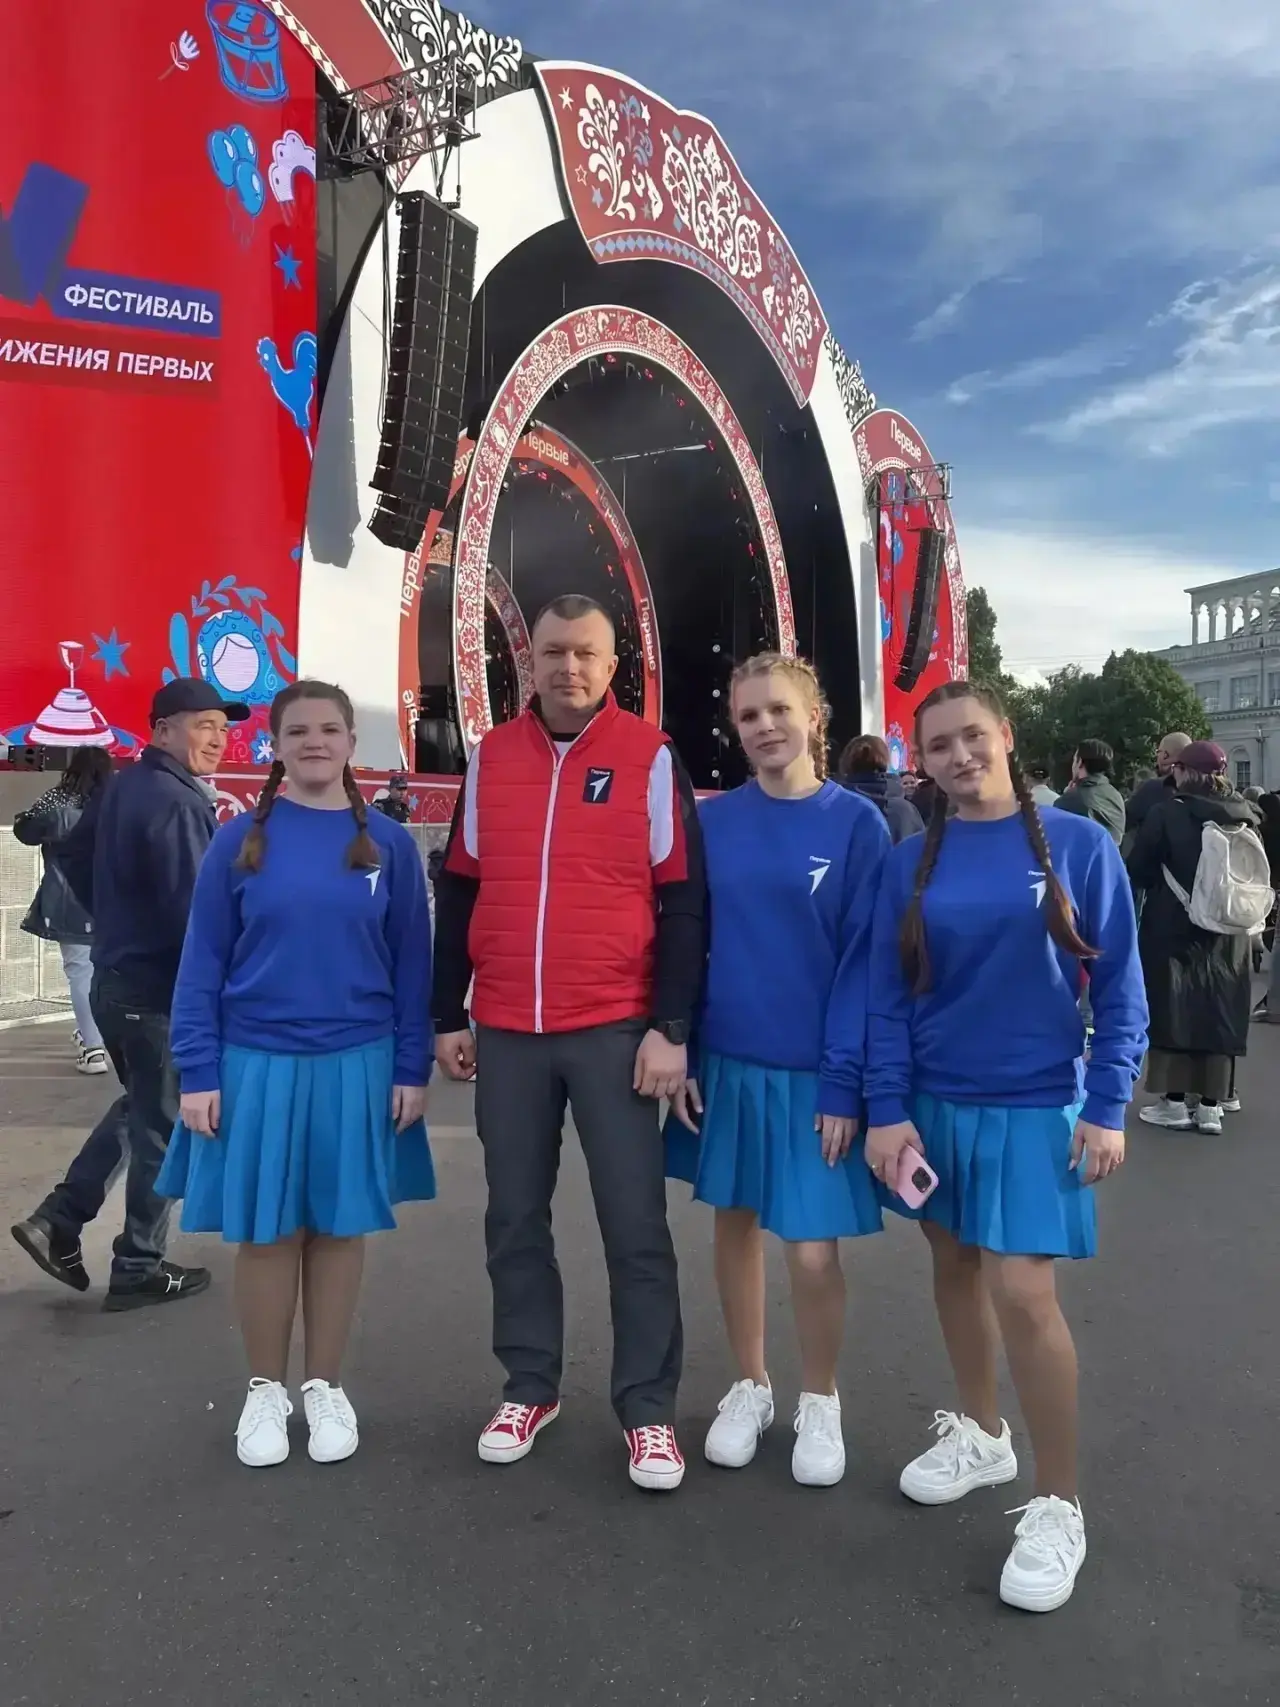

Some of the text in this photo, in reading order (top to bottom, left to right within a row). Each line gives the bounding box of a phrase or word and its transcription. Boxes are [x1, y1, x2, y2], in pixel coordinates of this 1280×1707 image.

[64, 283, 214, 324] ФЕСТИВАЛЬ
[116, 351, 214, 382] ПЕРВЫХ
[890, 418, 922, 462] Первые
